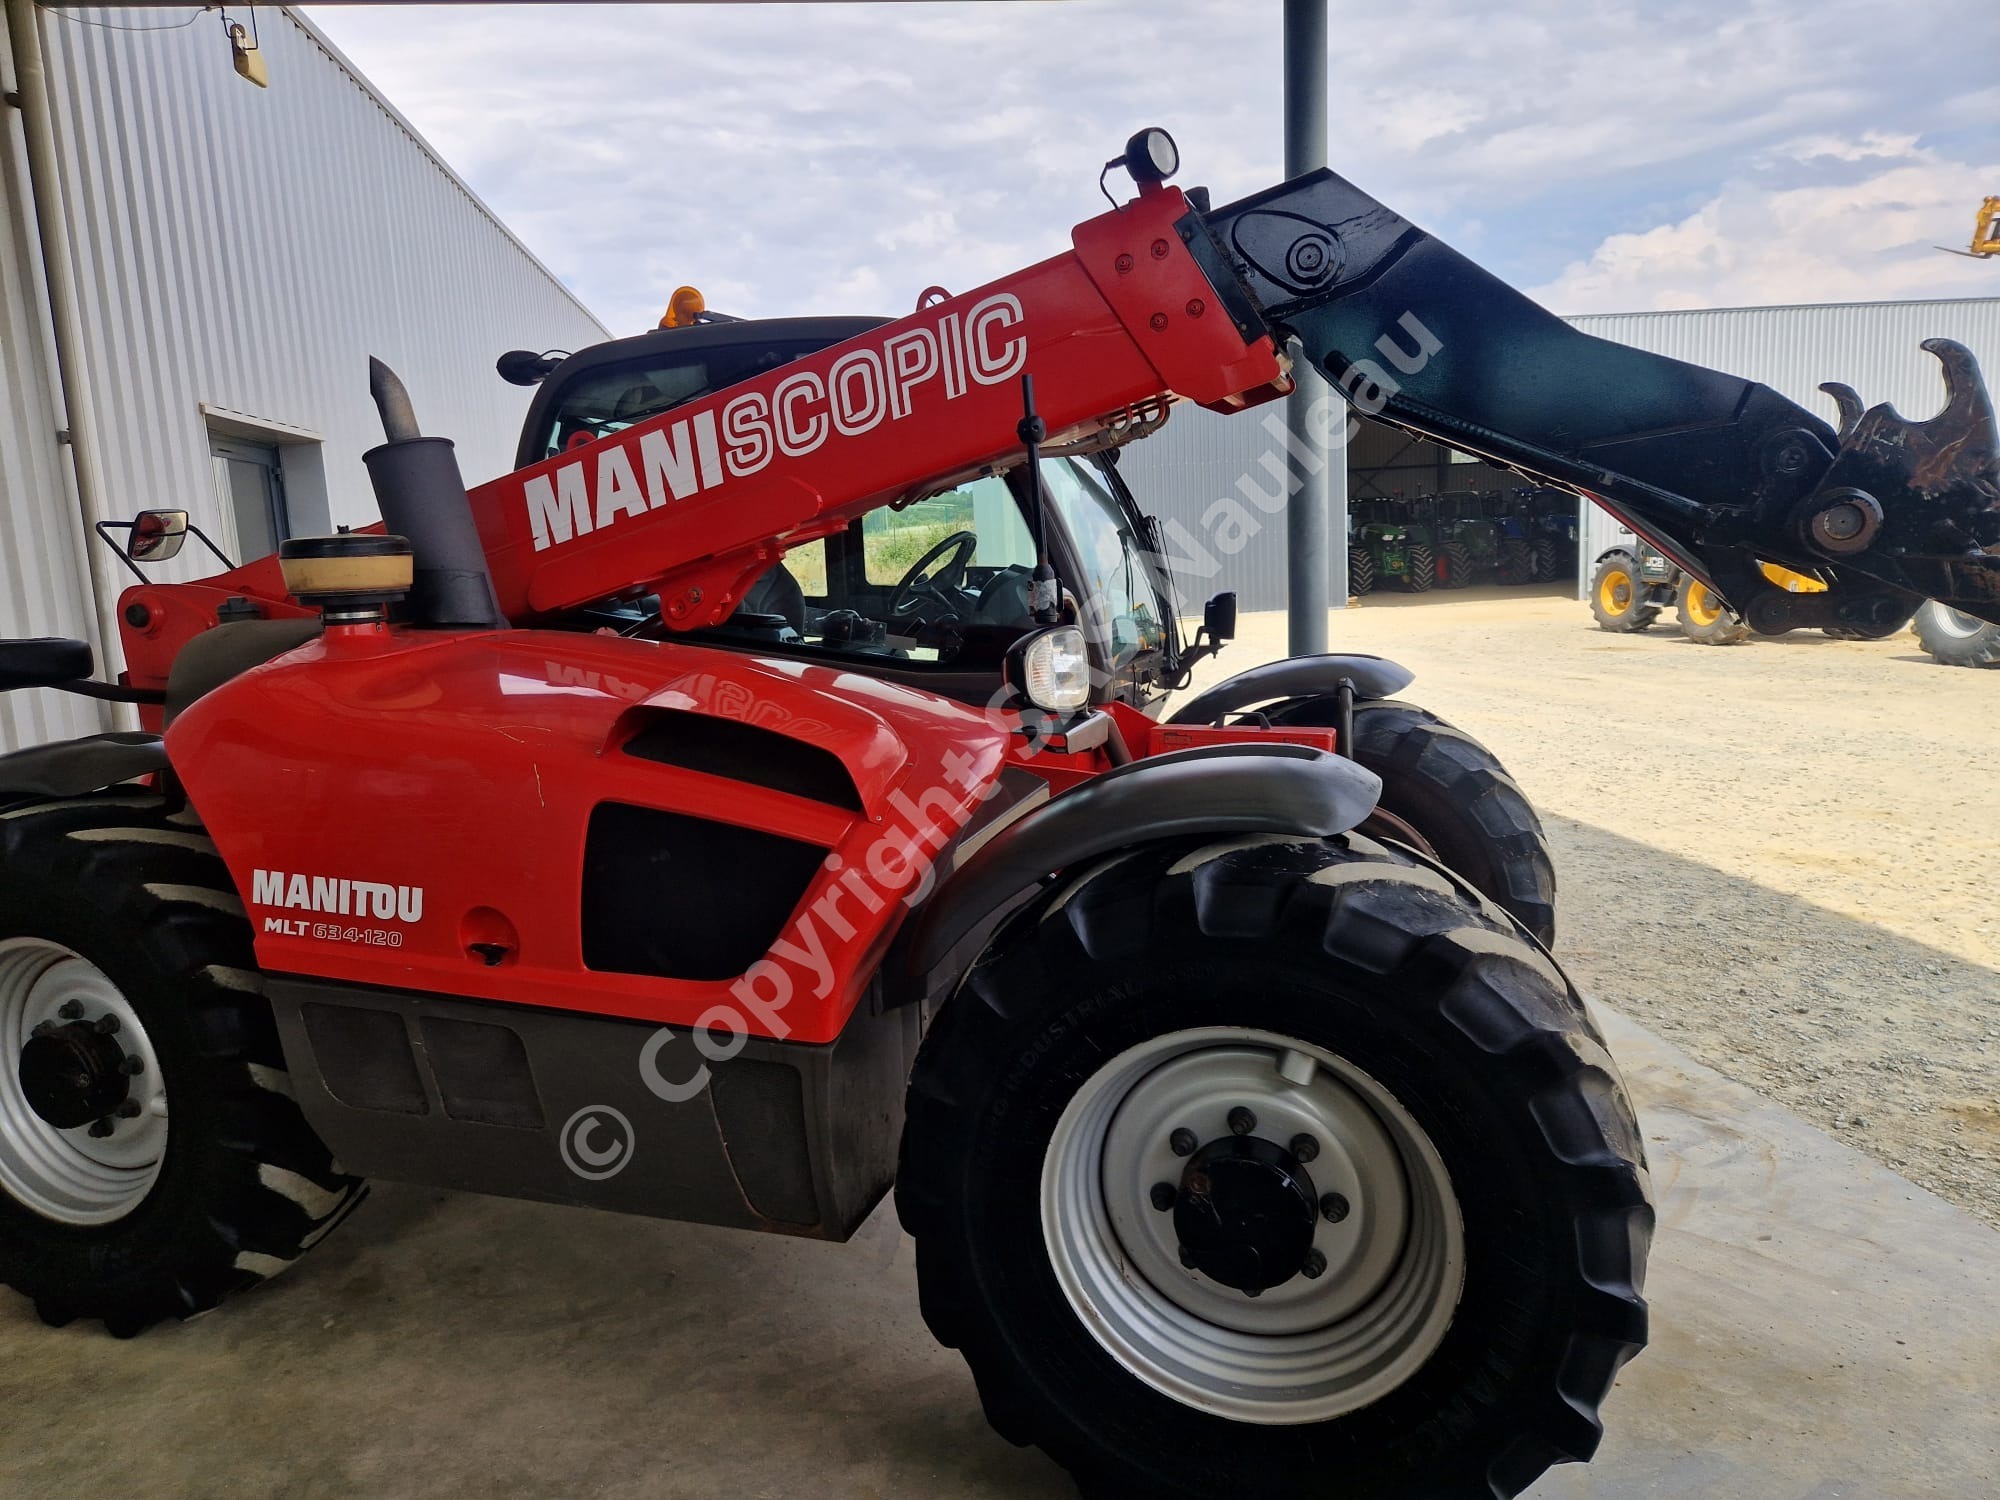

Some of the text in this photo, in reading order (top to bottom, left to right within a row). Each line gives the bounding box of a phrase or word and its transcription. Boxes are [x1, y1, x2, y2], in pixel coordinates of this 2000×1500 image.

[523, 292, 1028, 552] MANISCOPIC
[252, 868, 424, 923] MANITOU
[264, 917, 403, 948] MLT 634-120
